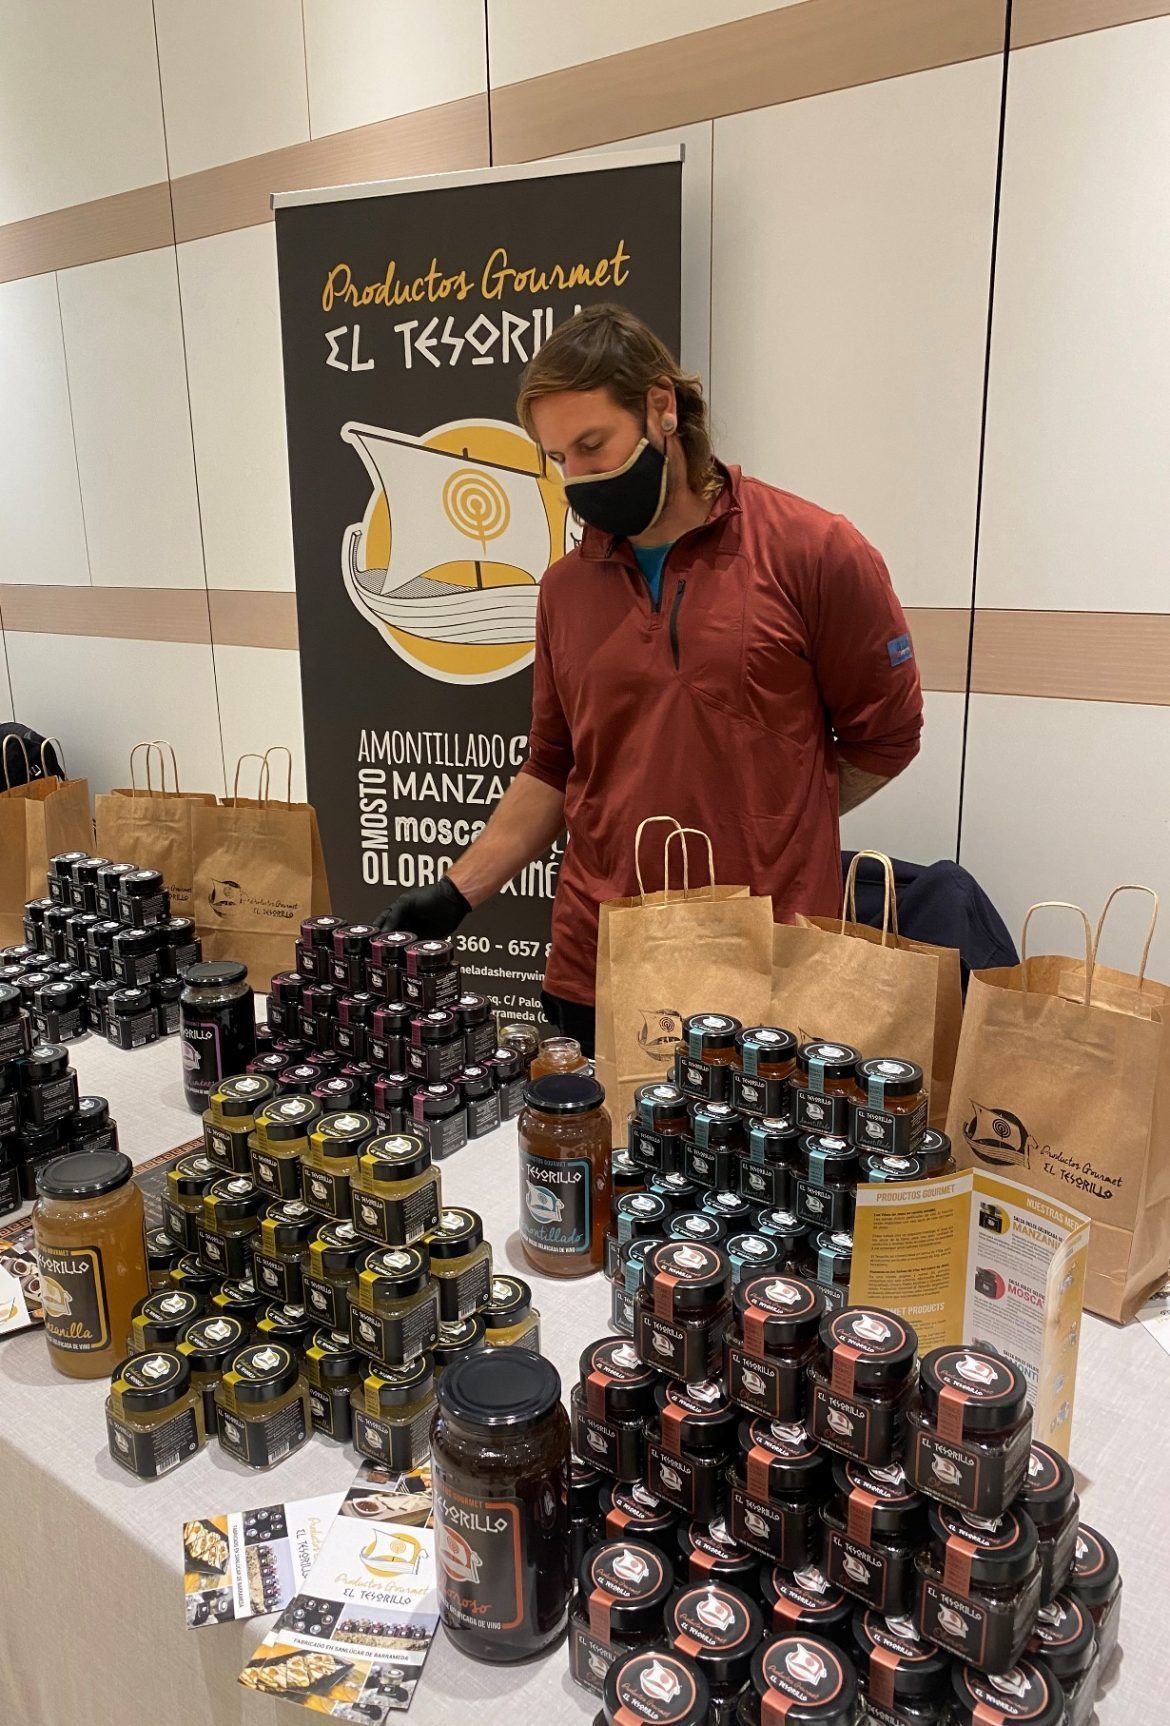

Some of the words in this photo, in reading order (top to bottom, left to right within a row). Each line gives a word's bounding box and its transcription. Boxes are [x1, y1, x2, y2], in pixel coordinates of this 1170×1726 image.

[322, 260, 474, 312] Productos
[481, 239, 631, 300] Gourmet
[324, 324, 375, 372] EL
[358, 730, 505, 769] AMONTILLADO
[393, 771, 514, 805] MANZA
[358, 768, 388, 850] MOSTO
[394, 816, 487, 845] mosca
[456, 934, 490, 953] 360
[508, 940, 540, 957] 657
[460, 965, 545, 982] eladasherrywin
[518, 997, 544, 1008] Palo
[526, 1164, 582, 1184] TESORILLO
[1040, 1145, 1080, 1170] Productos
[1082, 1163, 1123, 1187] Gourmet
[1044, 1163, 1056, 1176] EL
[1060, 1170, 1113, 1200] TESORILLO
[876, 1190, 922, 1202] PRODUCTOS
[922, 1184, 956, 1198] GOURMET
[1026, 1198, 1064, 1222] NUESTRAS
[38, 1254, 90, 1274] ESORILLO
[1008, 1283, 1046, 1308] MOSCA
[908, 1303, 944, 1315] PRODUCTS
[732, 1354, 740, 1364] EL
[818, 1392, 826, 1401] EL
[922, 1438, 931, 1448] EL
[438, 1496, 508, 1533] ESORILLO
[833, 1536, 842, 1546] EL
[343, 1588, 354, 1598] EL
[360, 1590, 412, 1605] TESORILLO
[928, 1587, 937, 1599] EL
[487, 1622, 501, 1630] VINO
[294, 1638, 325, 1650] FABRICADO
[374, 1652, 408, 1661] BARRAMEDA
[579, 1635, 586, 1645] EL
